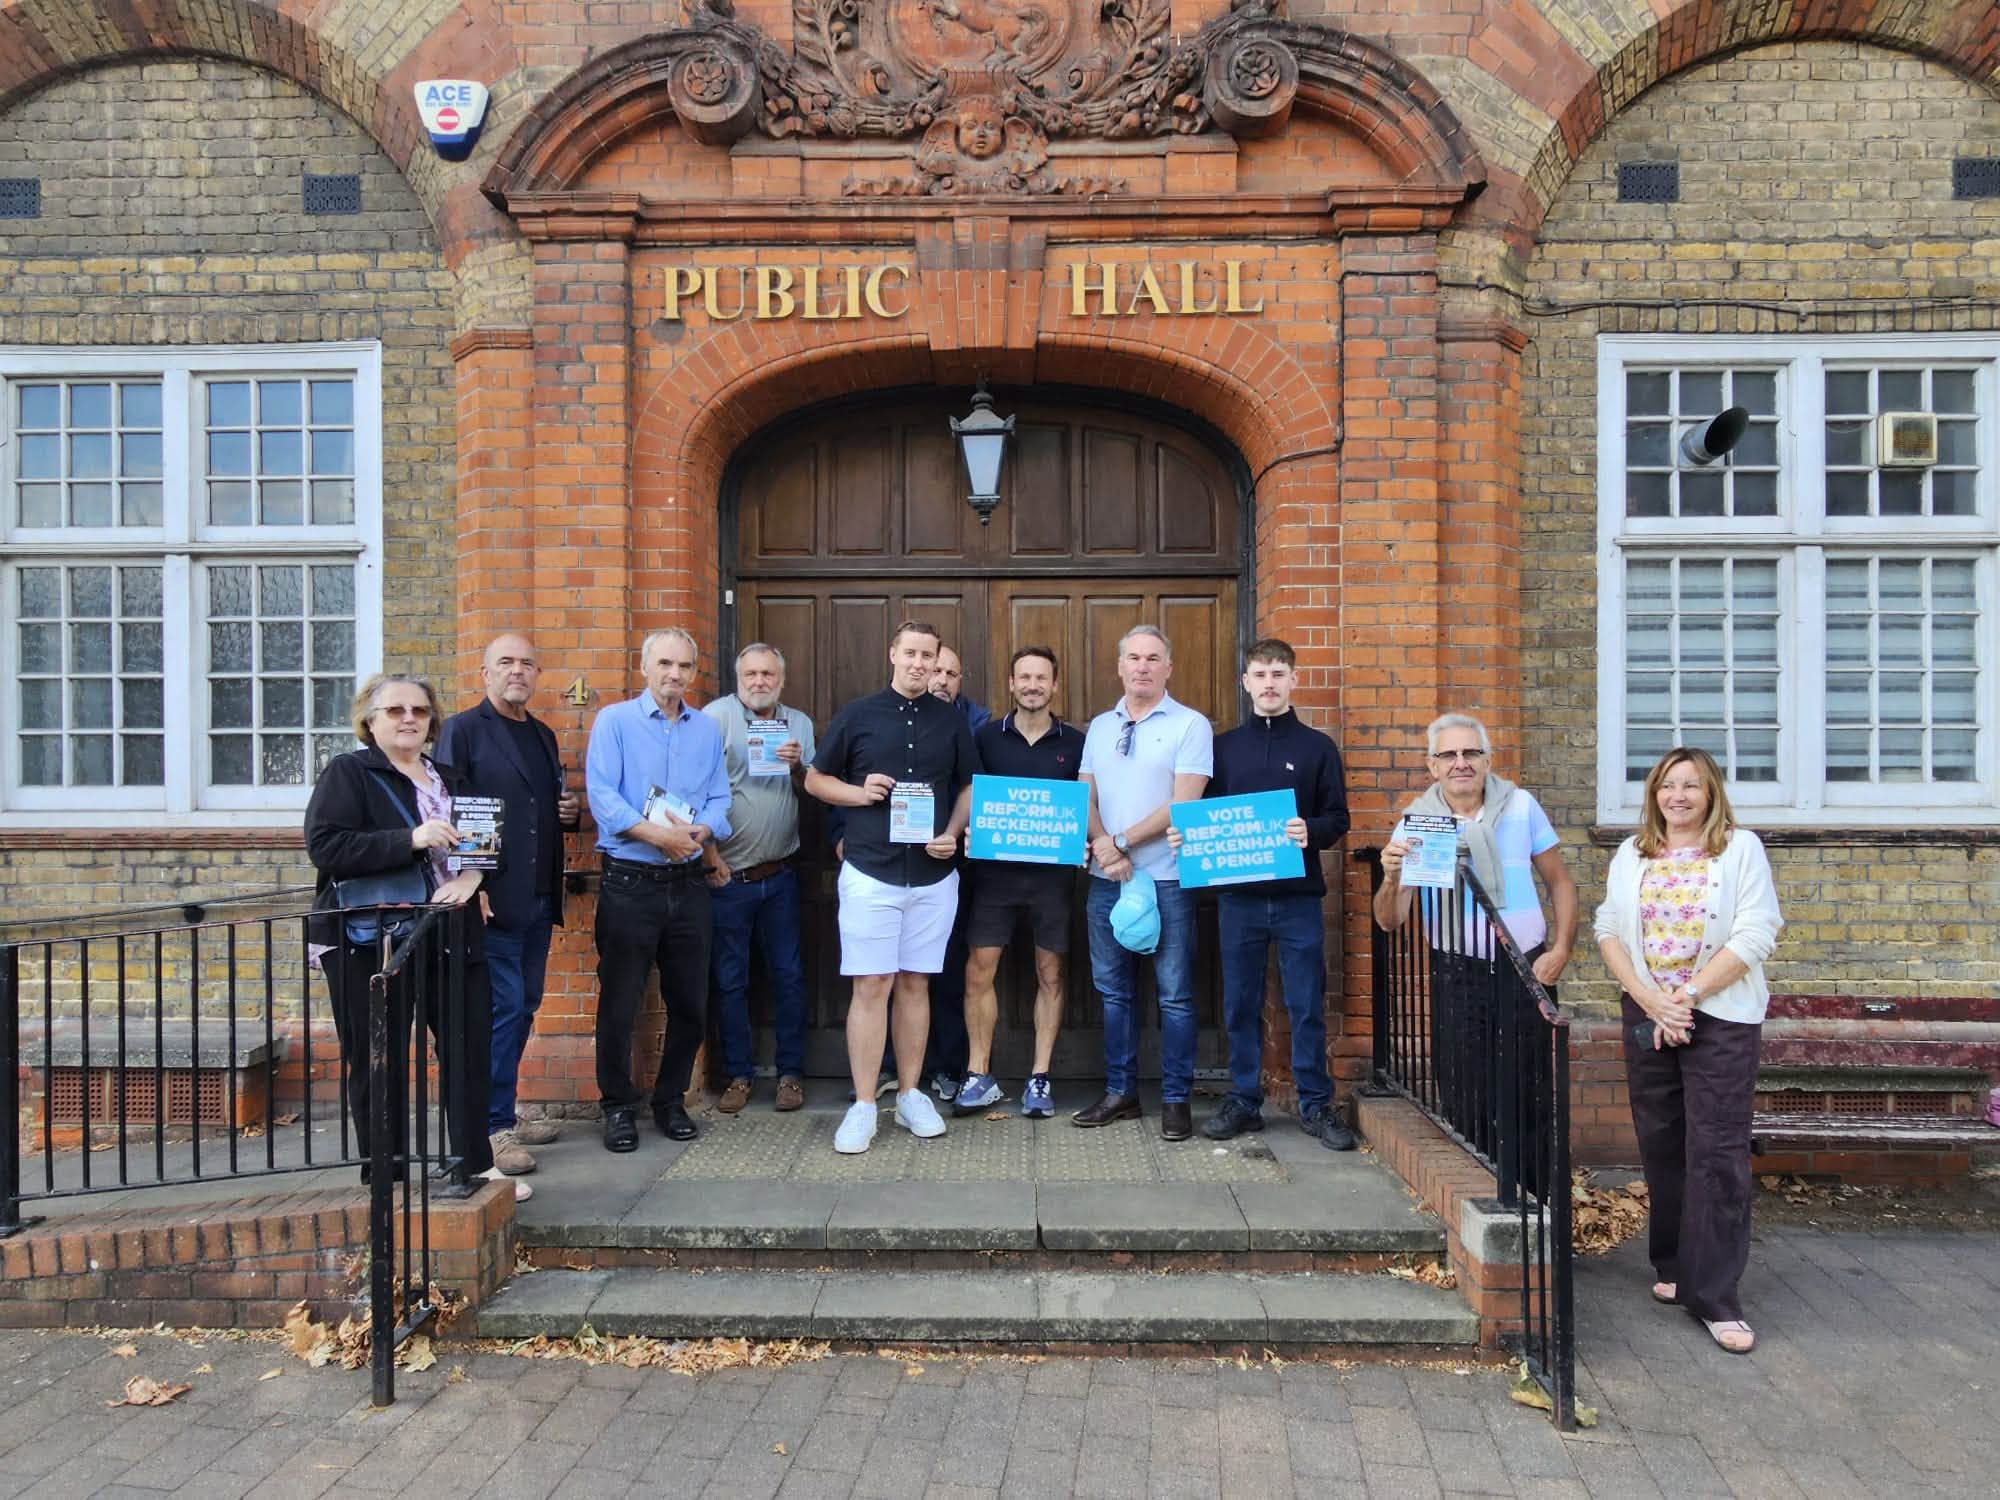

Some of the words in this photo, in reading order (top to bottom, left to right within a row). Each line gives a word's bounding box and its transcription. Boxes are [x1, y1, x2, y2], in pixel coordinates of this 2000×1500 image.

[425, 85, 471, 101] ACE
[663, 265, 910, 320] PUBLIC
[1070, 261, 1264, 315] HALL
[565, 676, 589, 706] 4
[1008, 788, 1051, 802] VOTE
[1208, 806, 1254, 822] VOTE
[976, 816, 1078, 835] BECKENHAM
[991, 832, 1002, 844] &
[1006, 833, 1061, 848] PENGE
[1181, 834, 1291, 857] BECKENHAM
[1201, 857, 1212, 870] &
[1216, 851, 1275, 868] PENGE
